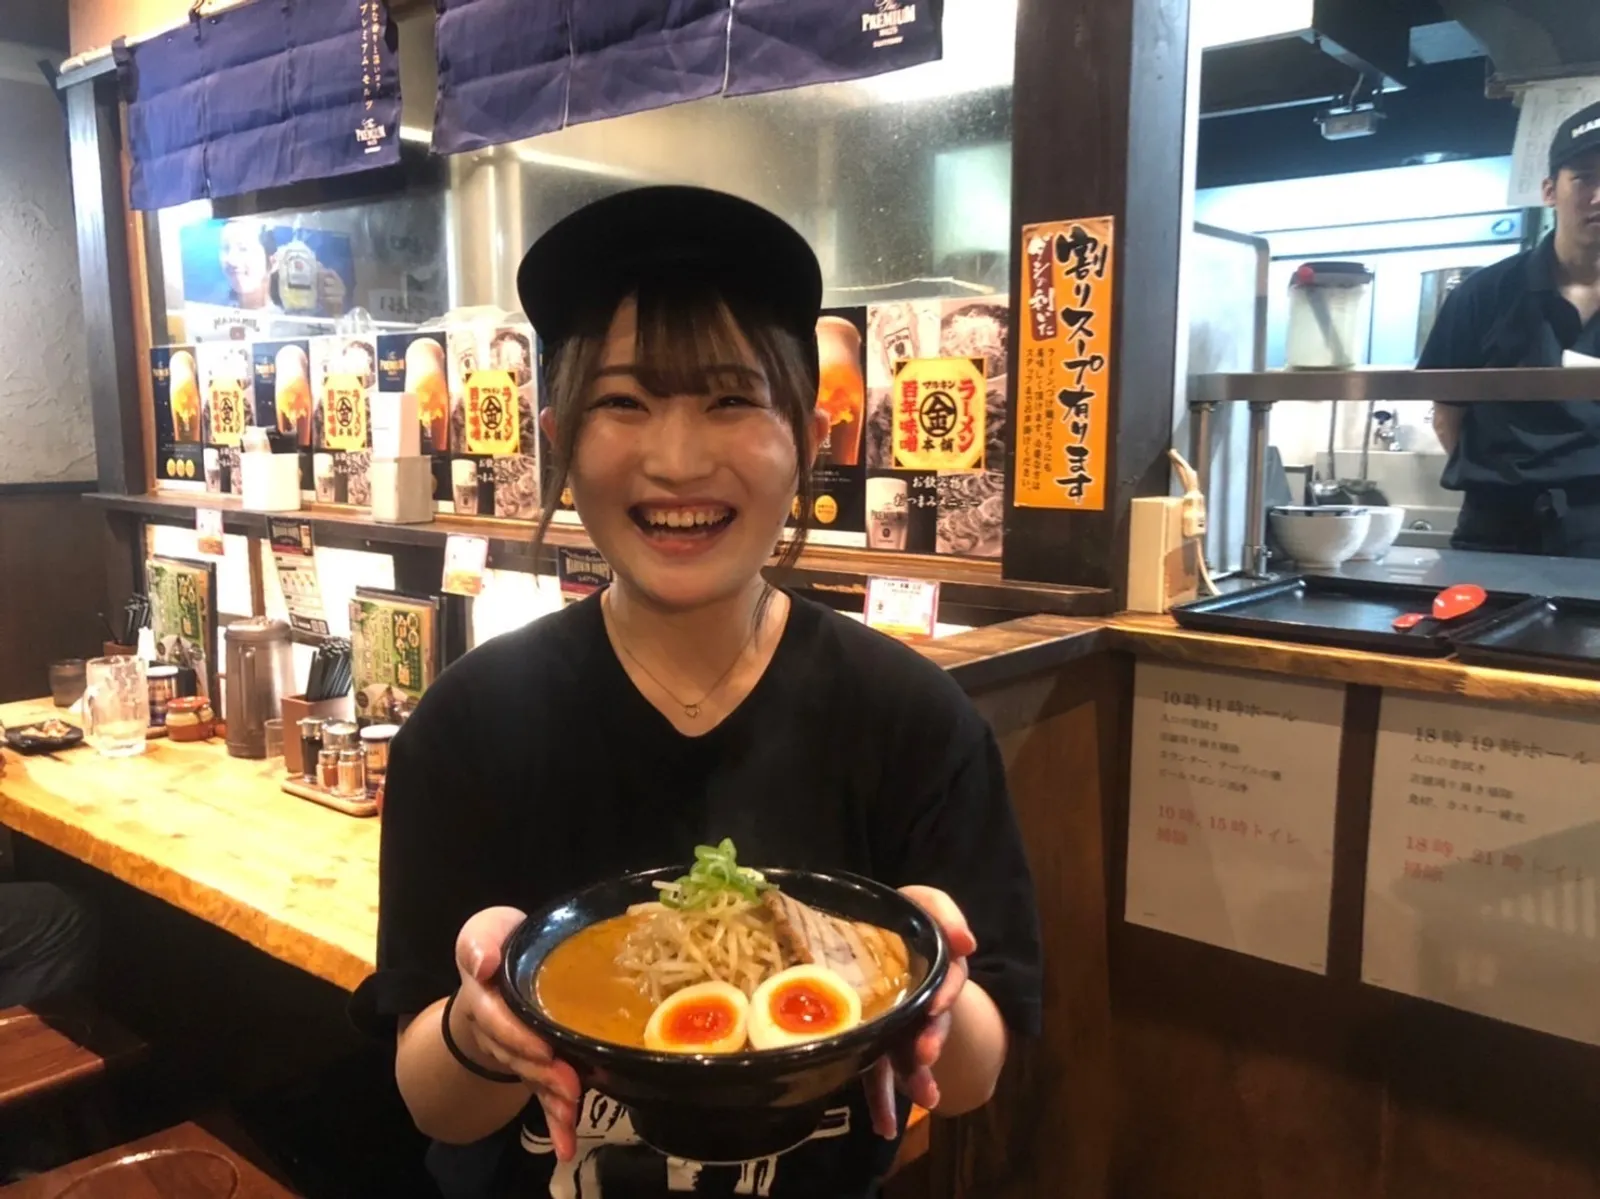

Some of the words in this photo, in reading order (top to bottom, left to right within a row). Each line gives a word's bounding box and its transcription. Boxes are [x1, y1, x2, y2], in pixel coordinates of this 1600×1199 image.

[861, 4, 917, 32] PREMIUM
[1027, 232, 1056, 338] ダシの利いた
[921, 380, 956, 390] マルキン
[1055, 225, 1108, 502] 割りスープ有ります
[900, 379, 920, 453] 百年味噌
[921, 437, 955, 453] 本舗
[958, 379, 978, 453] ラーメン
